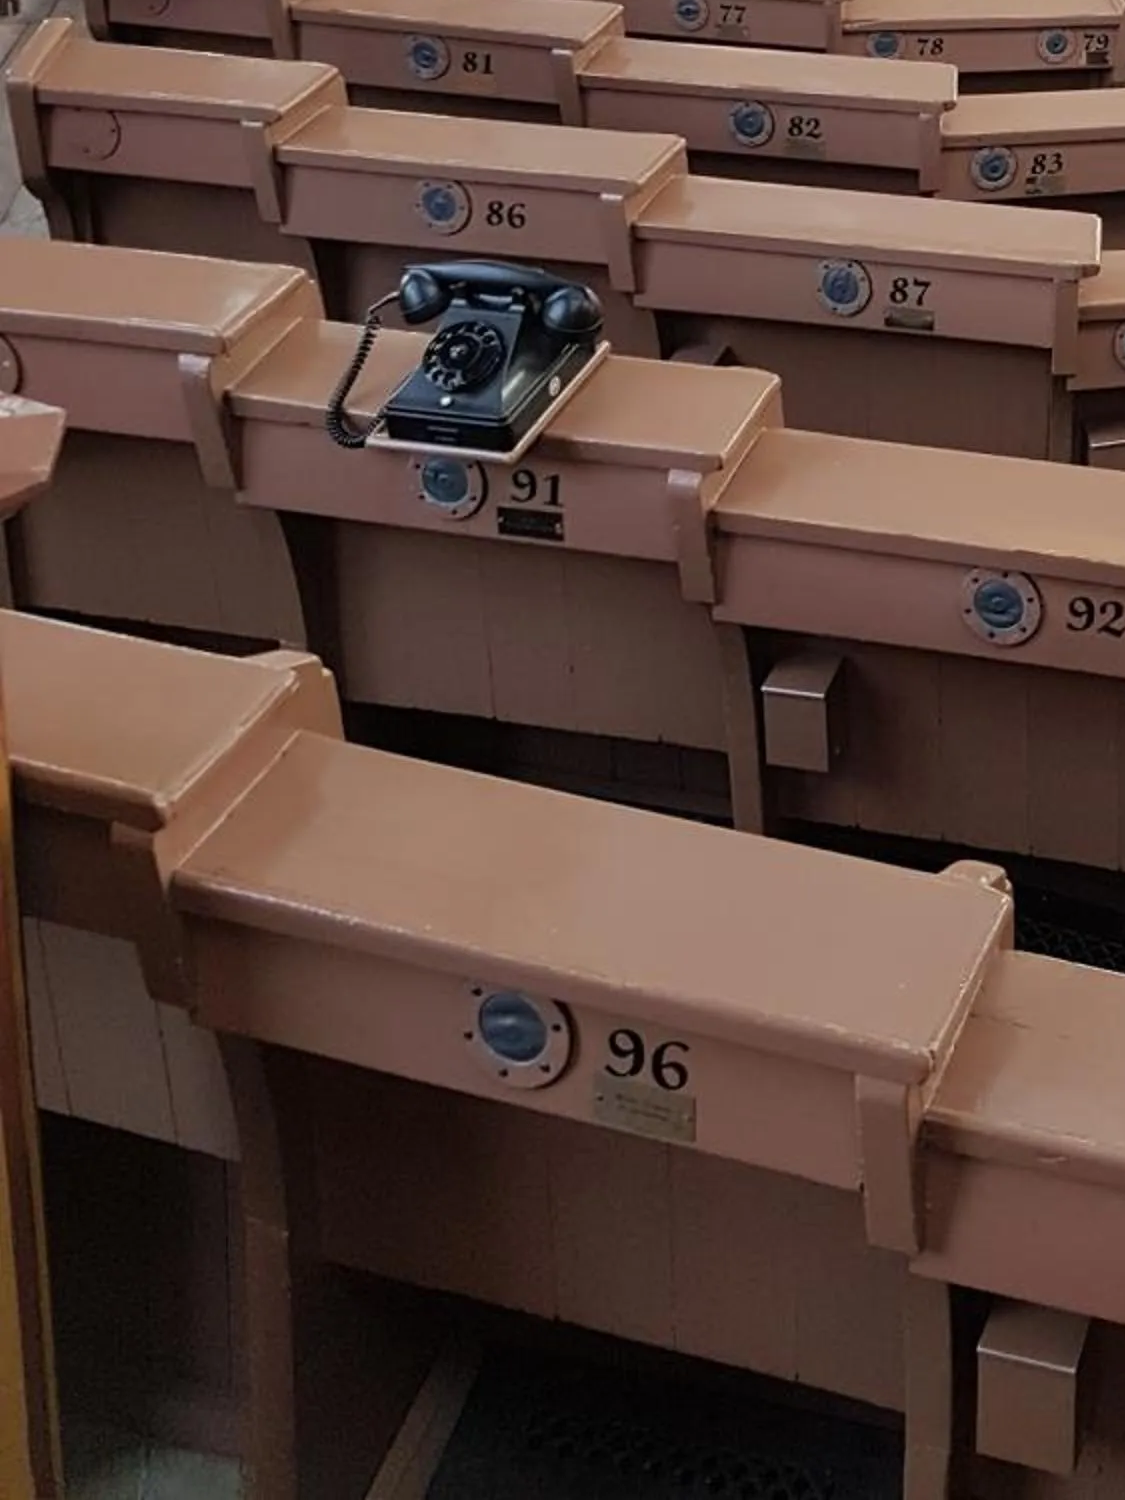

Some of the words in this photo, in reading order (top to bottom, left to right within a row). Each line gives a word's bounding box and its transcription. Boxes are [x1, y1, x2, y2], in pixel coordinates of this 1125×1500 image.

[719, 4, 747, 24] 77
[917, 37, 945, 56] 78
[1083, 33, 1110, 52] 79
[462, 52, 494, 75] 81
[787, 116, 823, 140] 82
[1030, 152, 1064, 176] 83
[485, 200, 527, 229] 86
[888, 276, 932, 306] 87
[511, 468, 564, 507] 91
[604, 1028, 691, 1091] 96
